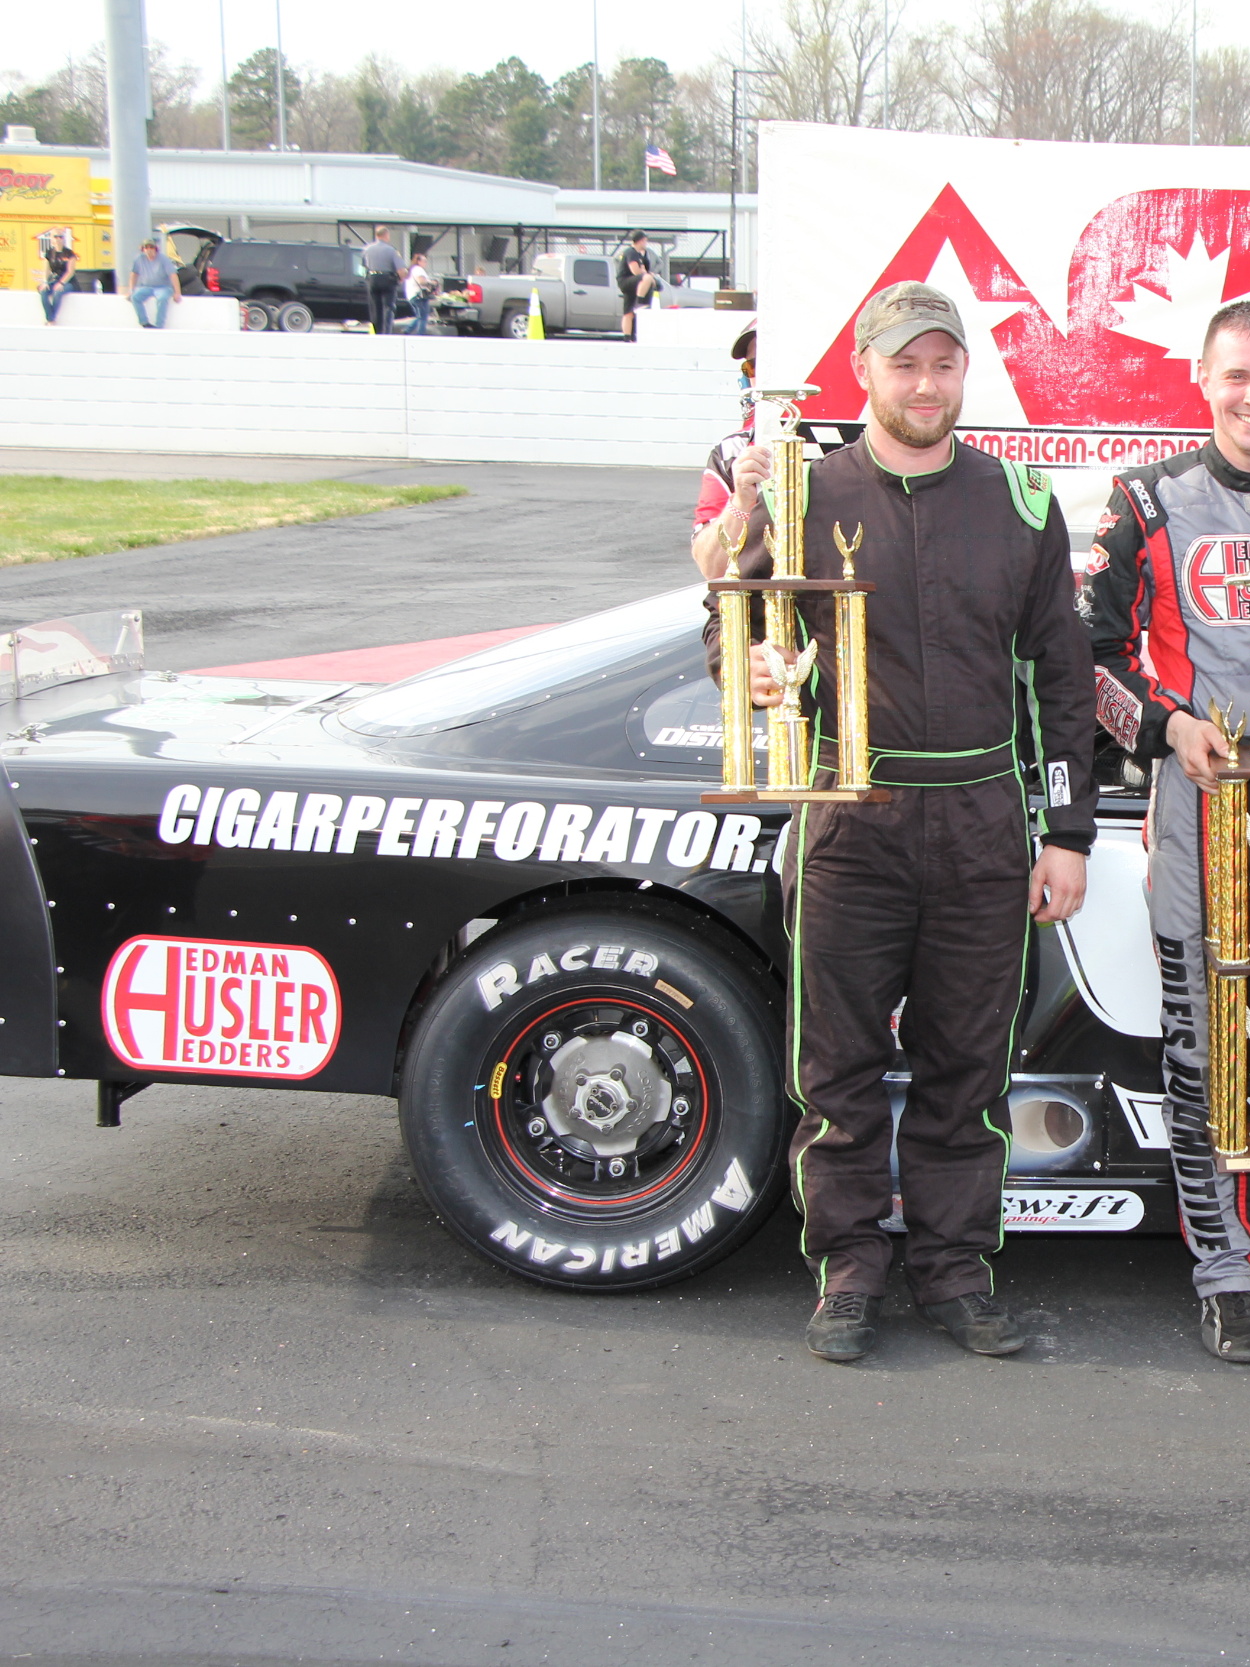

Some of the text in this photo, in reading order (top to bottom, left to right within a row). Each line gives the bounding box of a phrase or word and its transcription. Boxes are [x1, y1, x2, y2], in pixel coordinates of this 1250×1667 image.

[0, 168, 53, 189] OODY
[1130, 478, 1157, 518] sparco
[477, 945, 658, 1011] RACER
[490, 1157, 754, 1272] AMERICAN
[1003, 1213, 1060, 1225] prings
